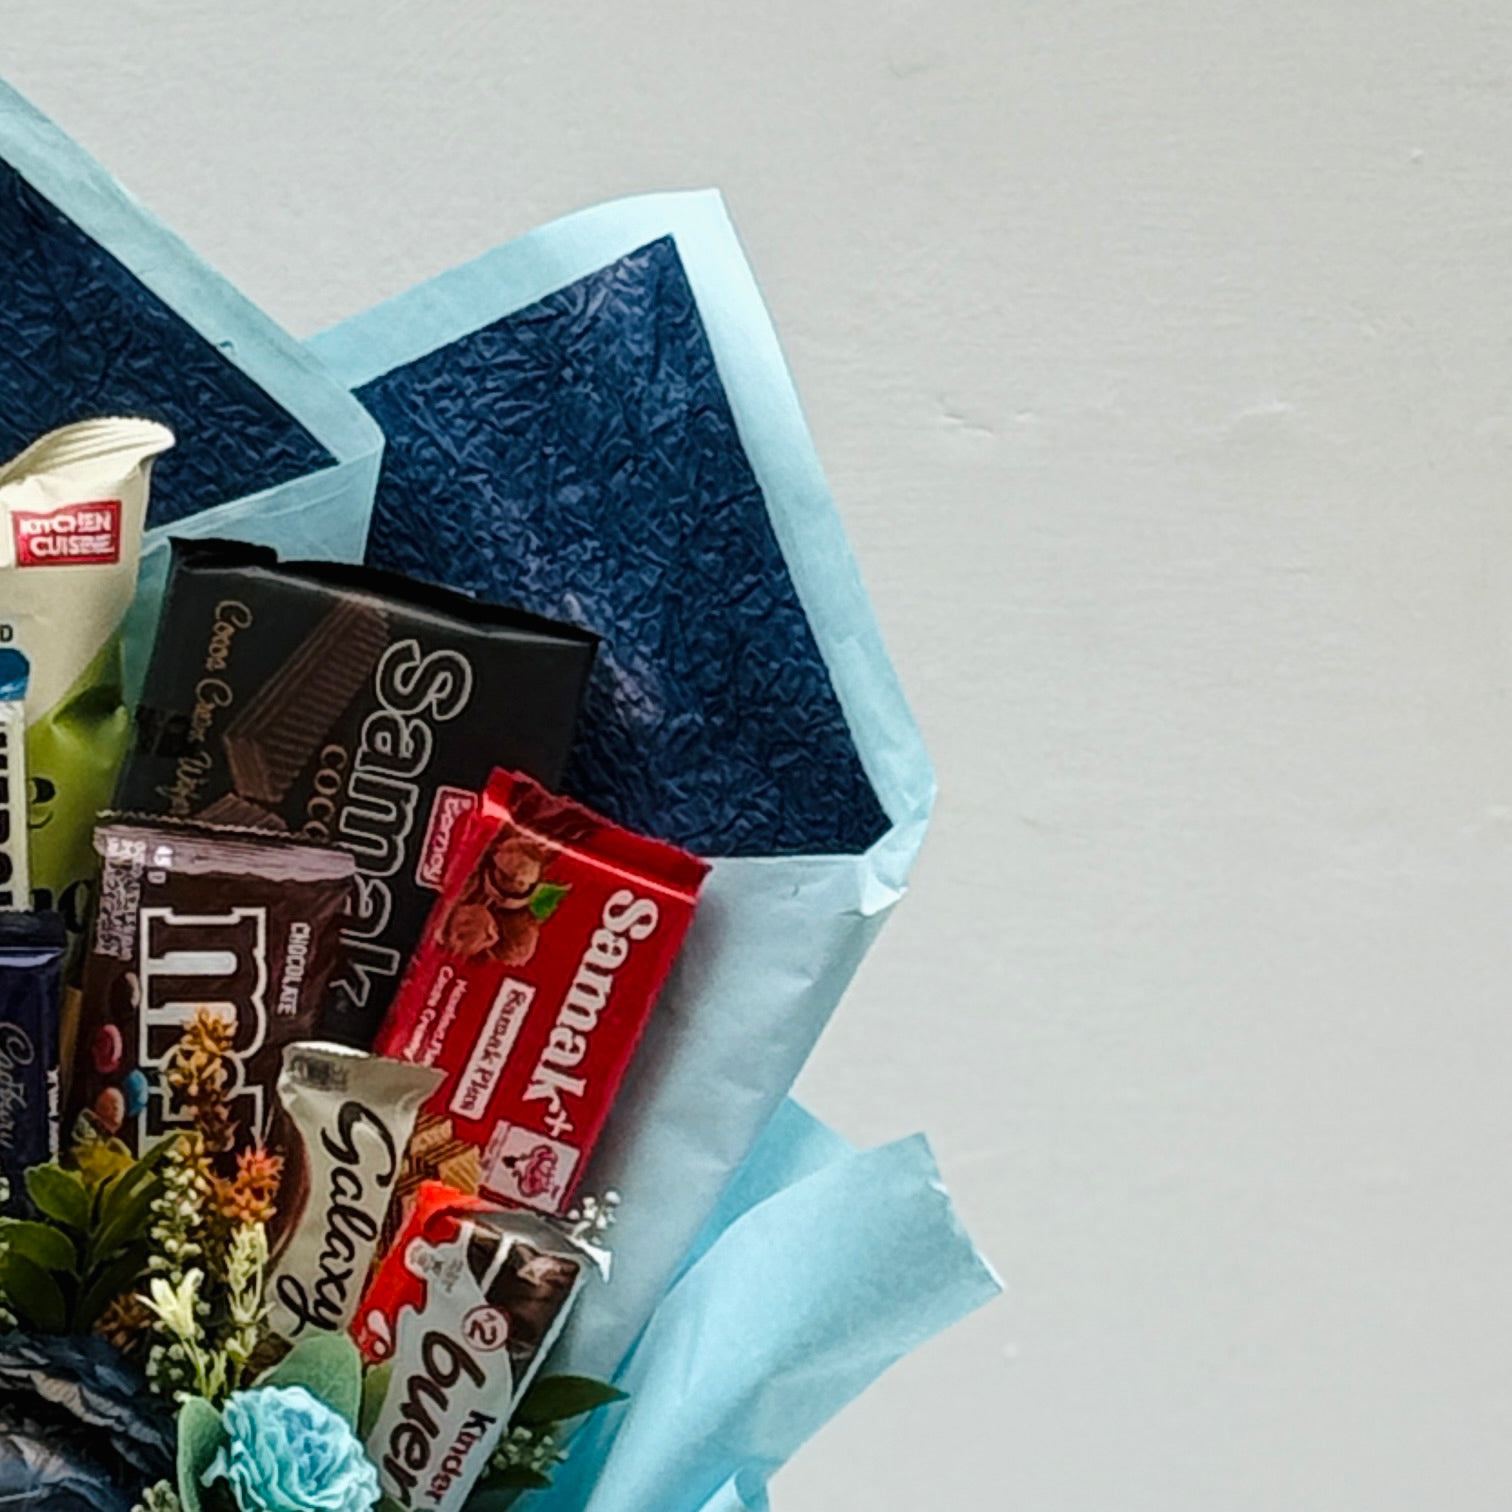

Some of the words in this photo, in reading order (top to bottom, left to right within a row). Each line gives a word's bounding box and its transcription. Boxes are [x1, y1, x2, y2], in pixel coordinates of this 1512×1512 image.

[18, 510, 112, 535] KITCHEN
[29, 533, 115, 557] CUISINE
[277, 921, 312, 1016] CHOCOLATE
[276, 1100, 397, 1338] Galaxy
